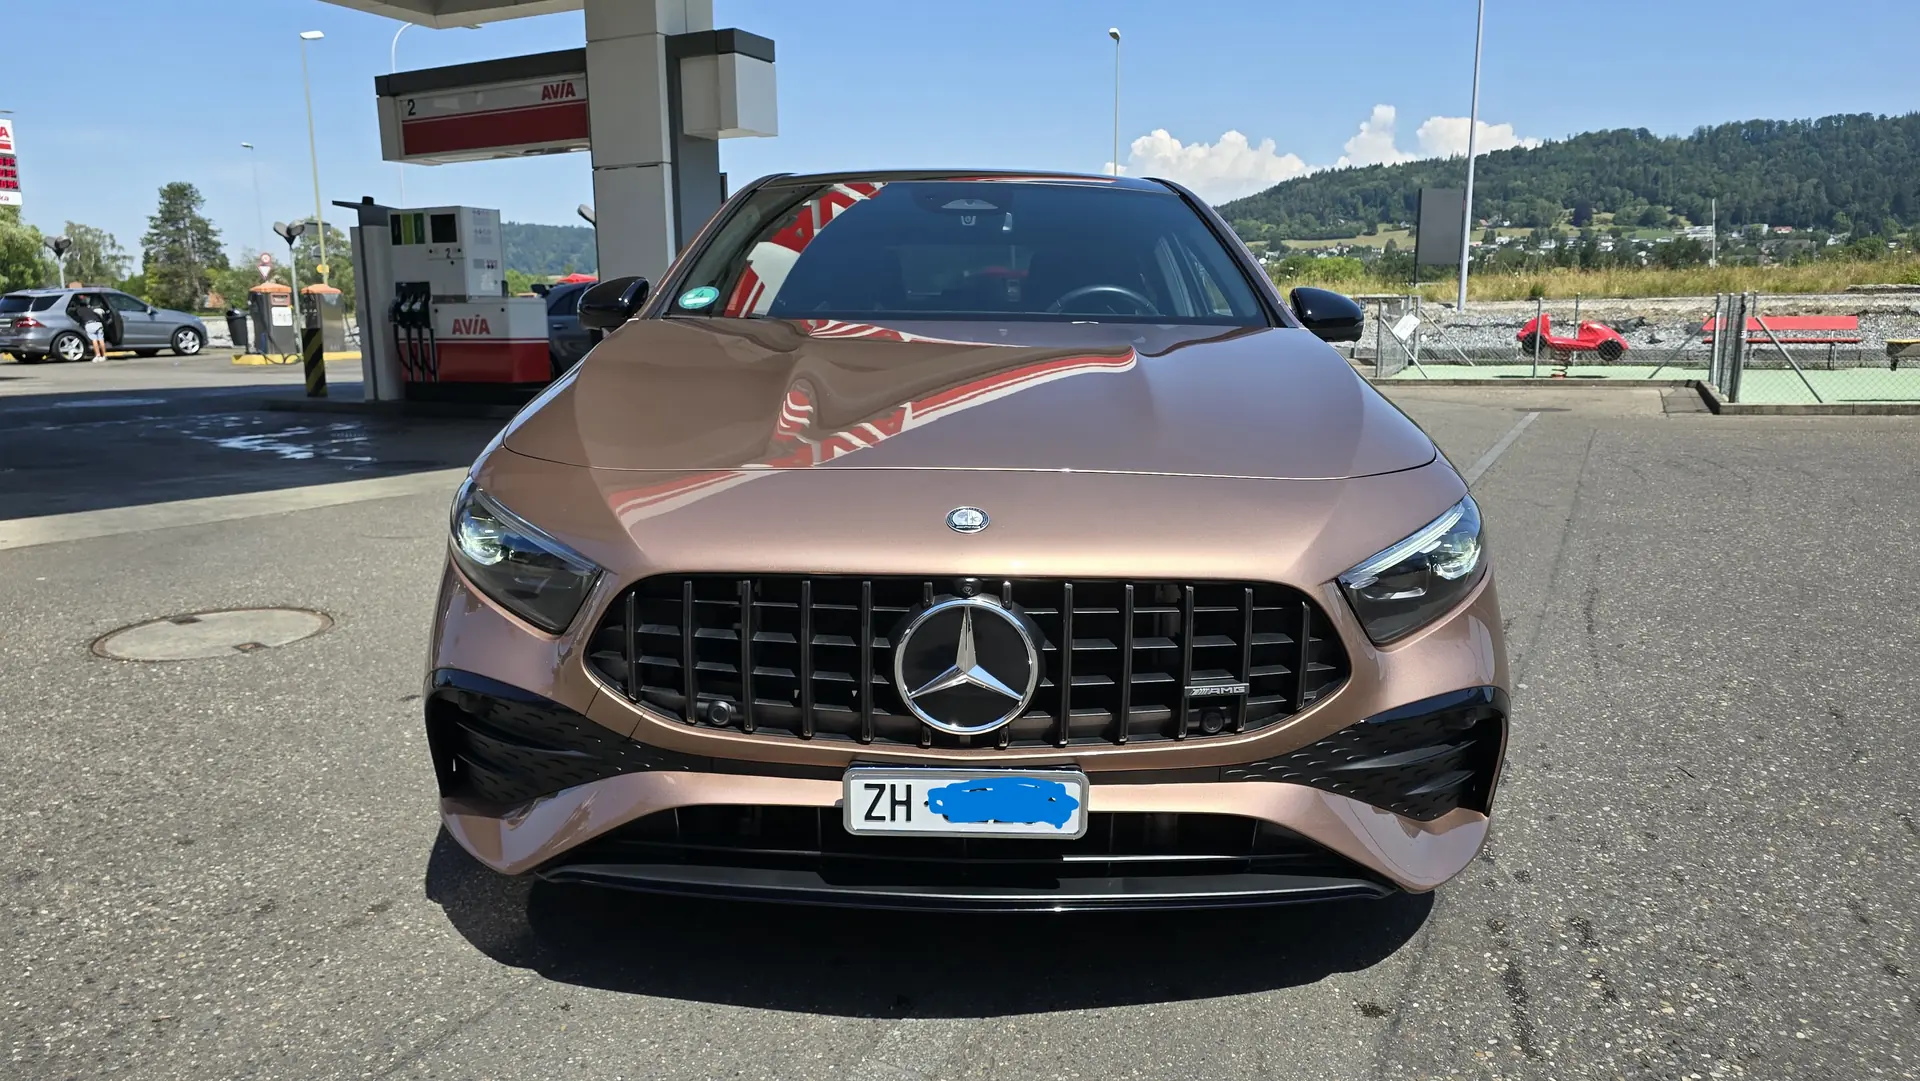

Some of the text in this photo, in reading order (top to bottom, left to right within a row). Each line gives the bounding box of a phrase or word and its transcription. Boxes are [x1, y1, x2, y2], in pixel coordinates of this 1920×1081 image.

[541, 80, 576, 101] AVIA
[407, 99, 416, 116] 2
[445, 247, 452, 259] 2
[452, 314, 491, 335] AVIA
[1207, 686, 1245, 695] AMG
[863, 783, 912, 822] ZH
